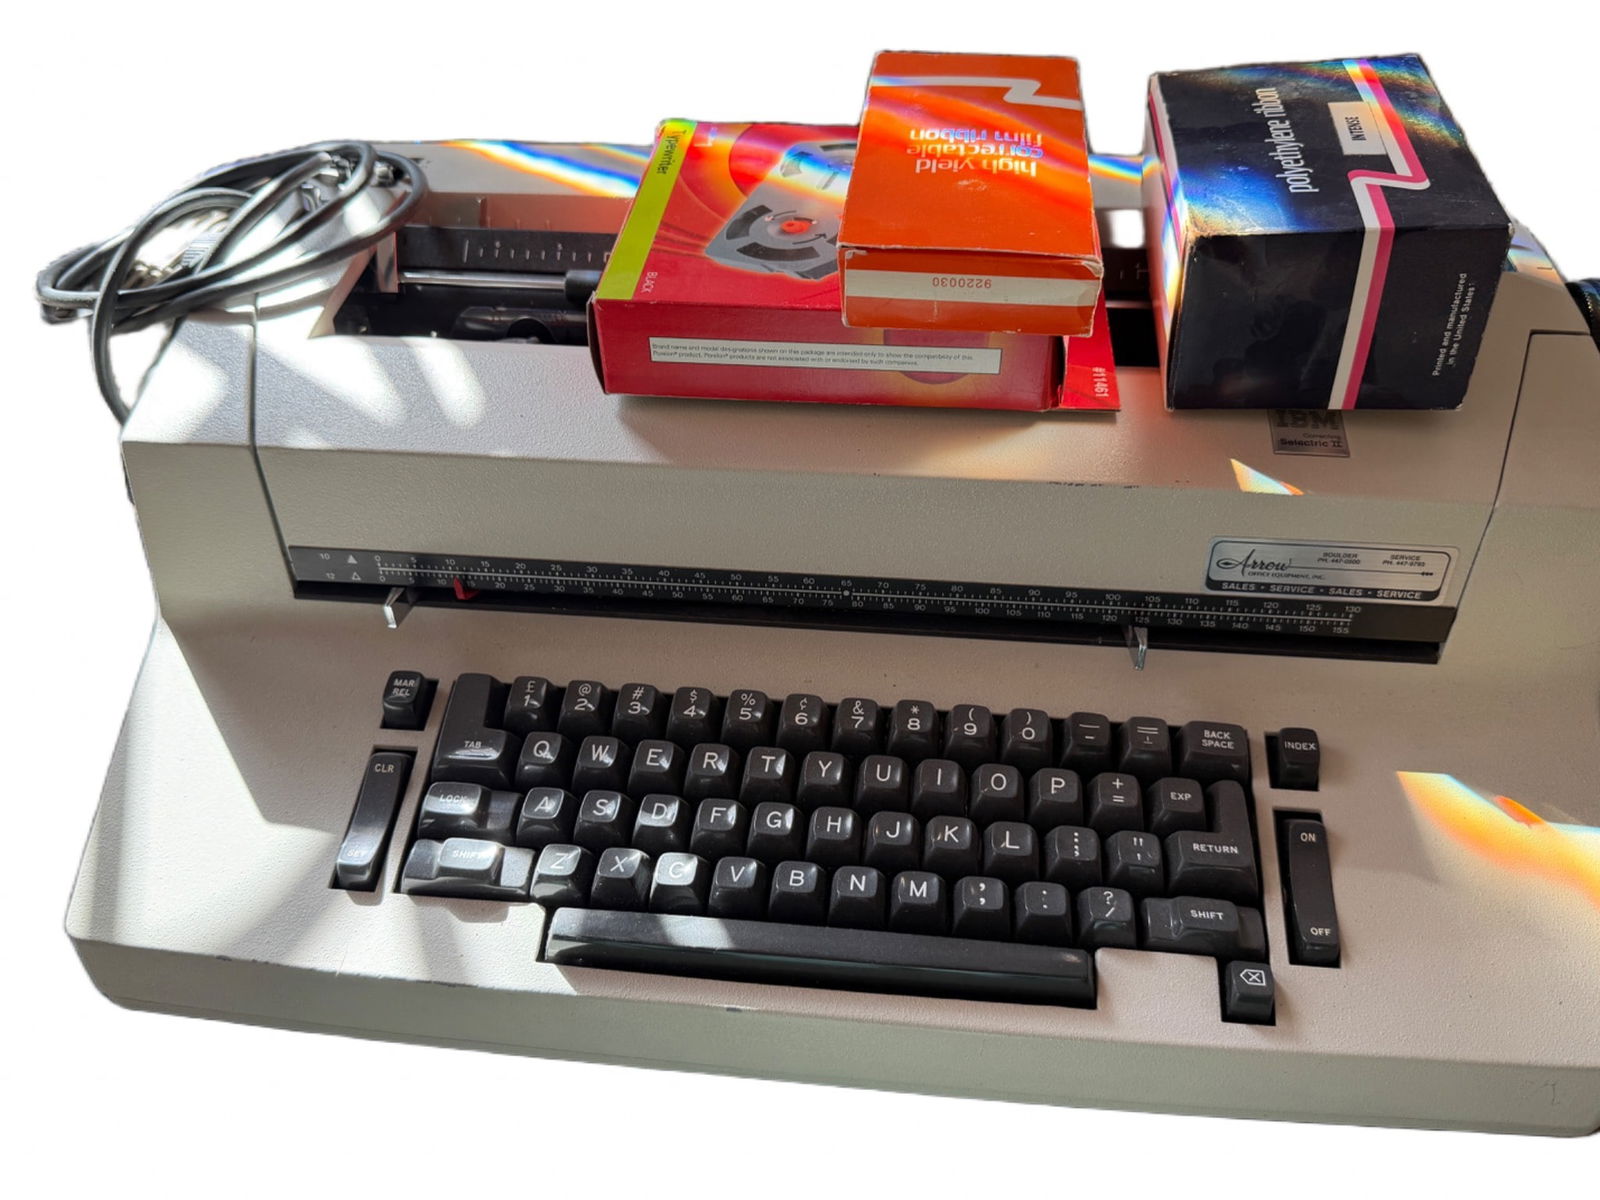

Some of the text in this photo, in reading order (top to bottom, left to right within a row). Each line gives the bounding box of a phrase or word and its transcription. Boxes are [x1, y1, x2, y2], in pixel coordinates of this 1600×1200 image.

[910, 127, 1042, 147] film ribbon
[1345, 116, 1367, 141] INTENSE
[1251, 88, 1319, 192] polyethylene ribbon
[656, 129, 687, 174] Typewriter
[906, 143, 1043, 159] correctable
[915, 157, 1037, 177] high yield
[640, 271, 658, 293] BLACK
[932, 277, 991, 288] 9220030
[1432, 273, 1467, 376] Printed and manufactured
[1453, 314, 1467, 341] United
[1450, 343, 1459, 355] the
[1092, 366, 1109, 397] #11461
[1277, 409, 1340, 429] IBM
[1280, 438, 1328, 447] Selectric
[320, 553, 330, 561] 10
[1216, 549, 1292, 576] Arrow
[515, 562, 526, 570] 20
[914, 583, 926, 591] 75
[1065, 591, 1077, 599] 95
[1105, 593, 1120, 601] 100
[1145, 595, 1160, 603] 105
[1185, 597, 1199, 605] 110
[1225, 599, 1239, 607] 115
[1263, 601, 1279, 610] 120
[1346, 605, 1361, 613] 130
[1222, 582, 1422, 599] SALES SERVICE SALES SERVICE
[495, 582, 506, 590] 20
[524, 584, 536, 592] 25
[554, 585, 565, 593] 30
[612, 588, 624, 596] 40
[672, 591, 683, 599] 50
[731, 594, 744, 602] 60
[762, 596, 774, 604] 65
[793, 597, 804, 605] 70
[822, 599, 833, 607] 75
[851, 600, 864, 608] 80
[883, 602, 894, 610] 85
[914, 603, 926, 611] 90
[943, 605, 956, 613] 95
[974, 607, 990, 615] 100
[1006, 609, 1022, 617] 105
[1037, 610, 1050, 618] 110
[1071, 612, 1084, 620] 115
[1102, 614, 1118, 622] 120
[1134, 615, 1150, 624] 125
[1199, 620, 1216, 628] 135
[1232, 621, 1248, 630] 140
[1265, 623, 1281, 632] 145
[1299, 625, 1315, 633] 150
[1332, 626, 1348, 635] 155
[392, 687, 410, 696] REL
[393, 679, 414, 687] MAR
[524, 694, 531, 707] 1
[574, 698, 588, 711] 2
[628, 701, 642, 714] 3
[683, 705, 697, 716] 4
[739, 707, 752, 720] 5
[795, 712, 808, 726] 6
[852, 716, 864, 729] 7
[907, 717, 921, 731] 8
[964, 722, 977, 736] 9
[1021, 727, 1036, 740] 0
[1203, 729, 1231, 741] BACK
[464, 740, 482, 749] TAB
[534, 741, 550, 758] Q
[591, 744, 610, 761] W
[1201, 738, 1235, 750] SPACE
[1283, 741, 1316, 751] INDEX
[646, 748, 663, 765] E
[703, 752, 718, 769] R
[762, 755, 777, 772] T
[374, 763, 395, 773] CLR
[818, 760, 833, 777] Y
[876, 764, 891, 783] U
[936, 769, 942, 786] I
[991, 773, 1006, 791] O
[1050, 778, 1065, 794] P
[535, 797, 551, 813] A
[1170, 791, 1192, 802] EXP
[593, 799, 608, 816] S
[651, 803, 667, 820] D
[710, 807, 726, 823] F
[766, 811, 782, 828] G
[826, 815, 841, 833] H
[886, 822, 901, 838] J
[944, 825, 959, 842] K
[1300, 832, 1316, 842] ON
[1005, 831, 1019, 848] L
[1192, 842, 1238, 855] RETURN
[551, 853, 569, 869] Z
[610, 856, 627, 873] X
[667, 861, 684, 878] C
[730, 866, 746, 882] V
[789, 870, 805, 887] B
[850, 874, 865, 891] N
[909, 880, 927, 898] M
[1190, 909, 1224, 922] SHIFT
[1310, 926, 1331, 937] OFF
